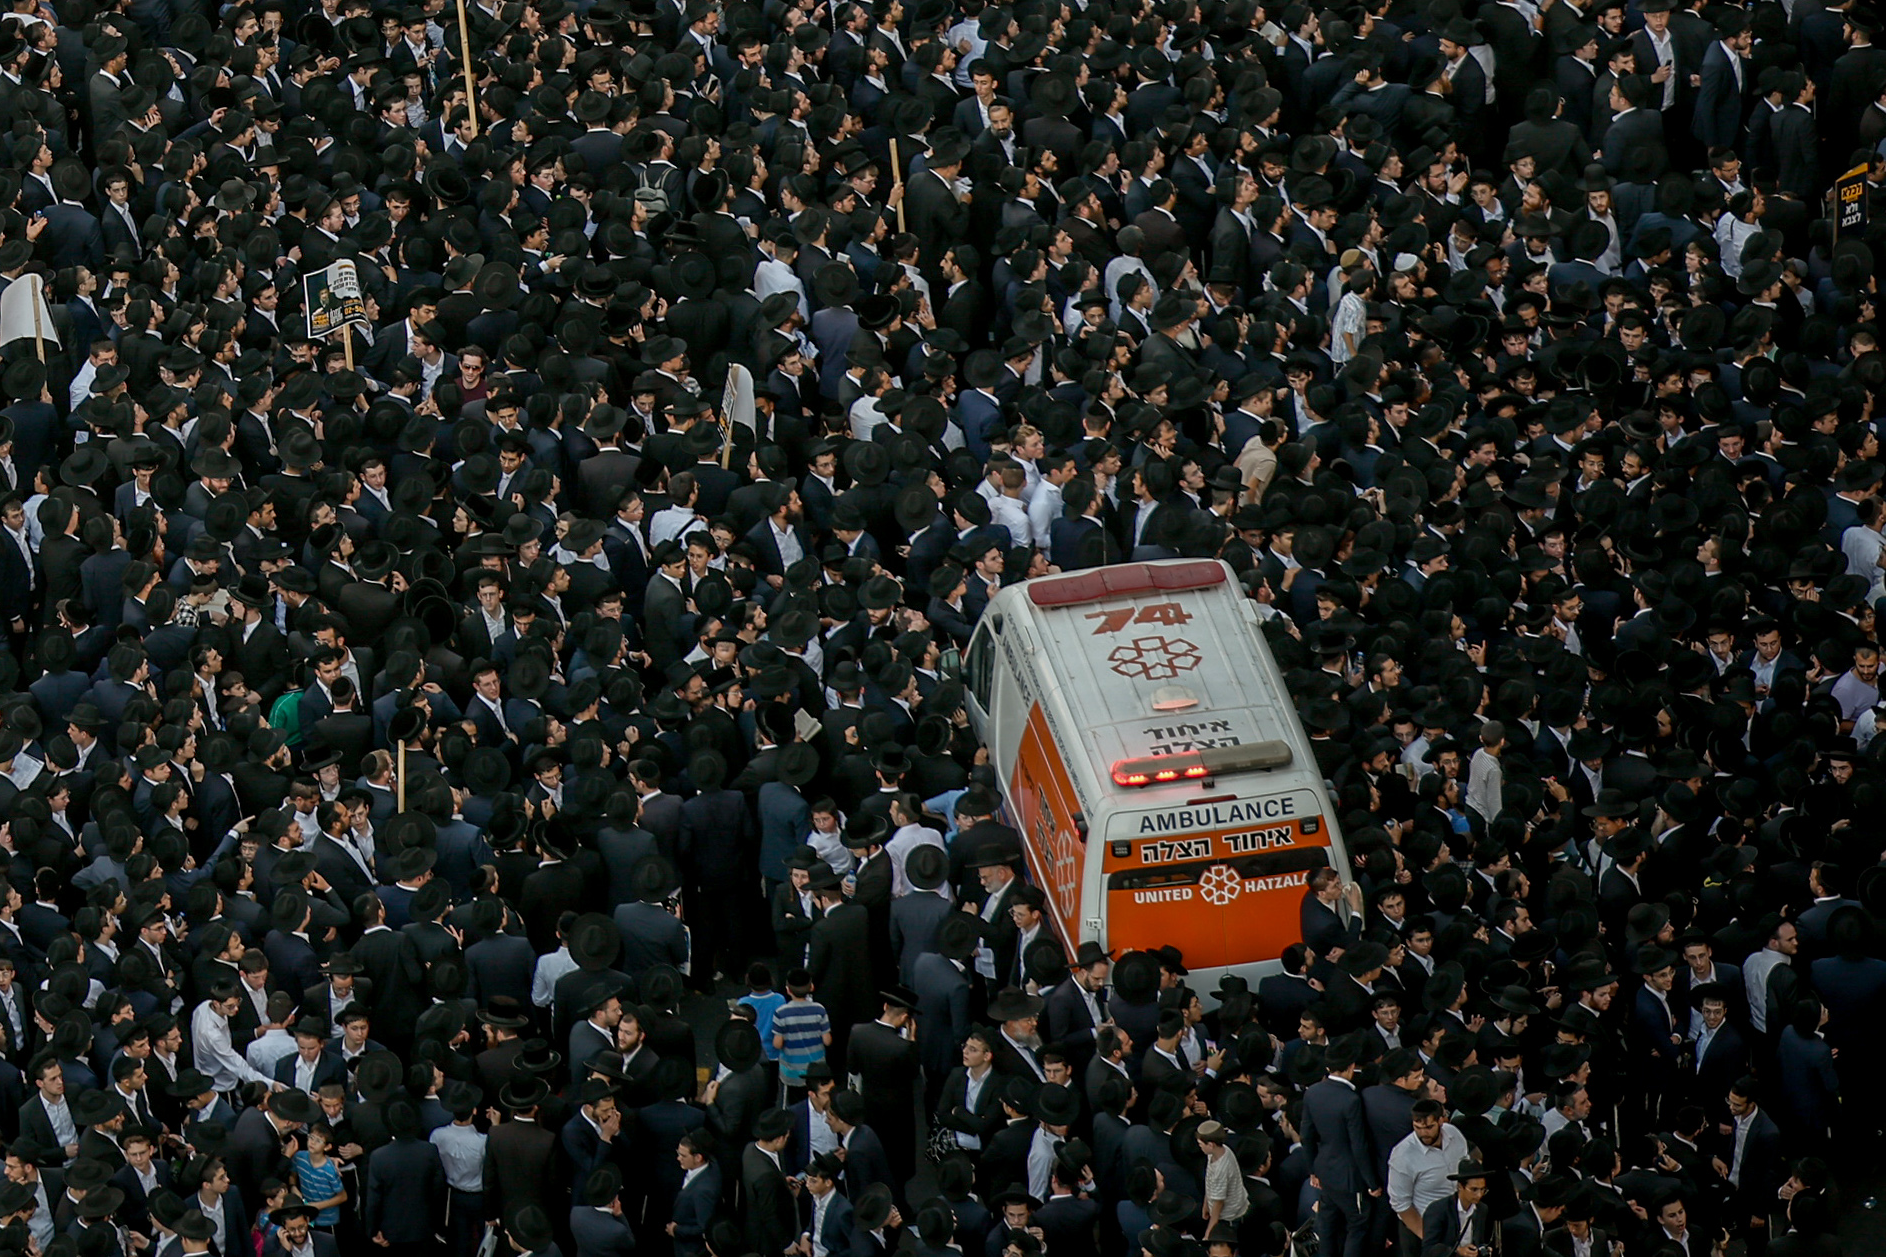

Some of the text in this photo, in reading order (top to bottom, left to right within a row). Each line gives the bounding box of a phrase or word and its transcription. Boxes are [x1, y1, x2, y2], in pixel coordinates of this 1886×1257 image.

[1843, 184, 1861, 198] לכלא
[1845, 202, 1859, 215] ולא
[1841, 211, 1862, 228] לצבא
[1084, 602, 1193, 635] 74
[1142, 719, 1233, 740] איחוד
[1139, 797, 1295, 834] AMBULANCE
[1140, 826, 1295, 864] איחוד הצלה
[1134, 887, 1193, 904] UNITED
